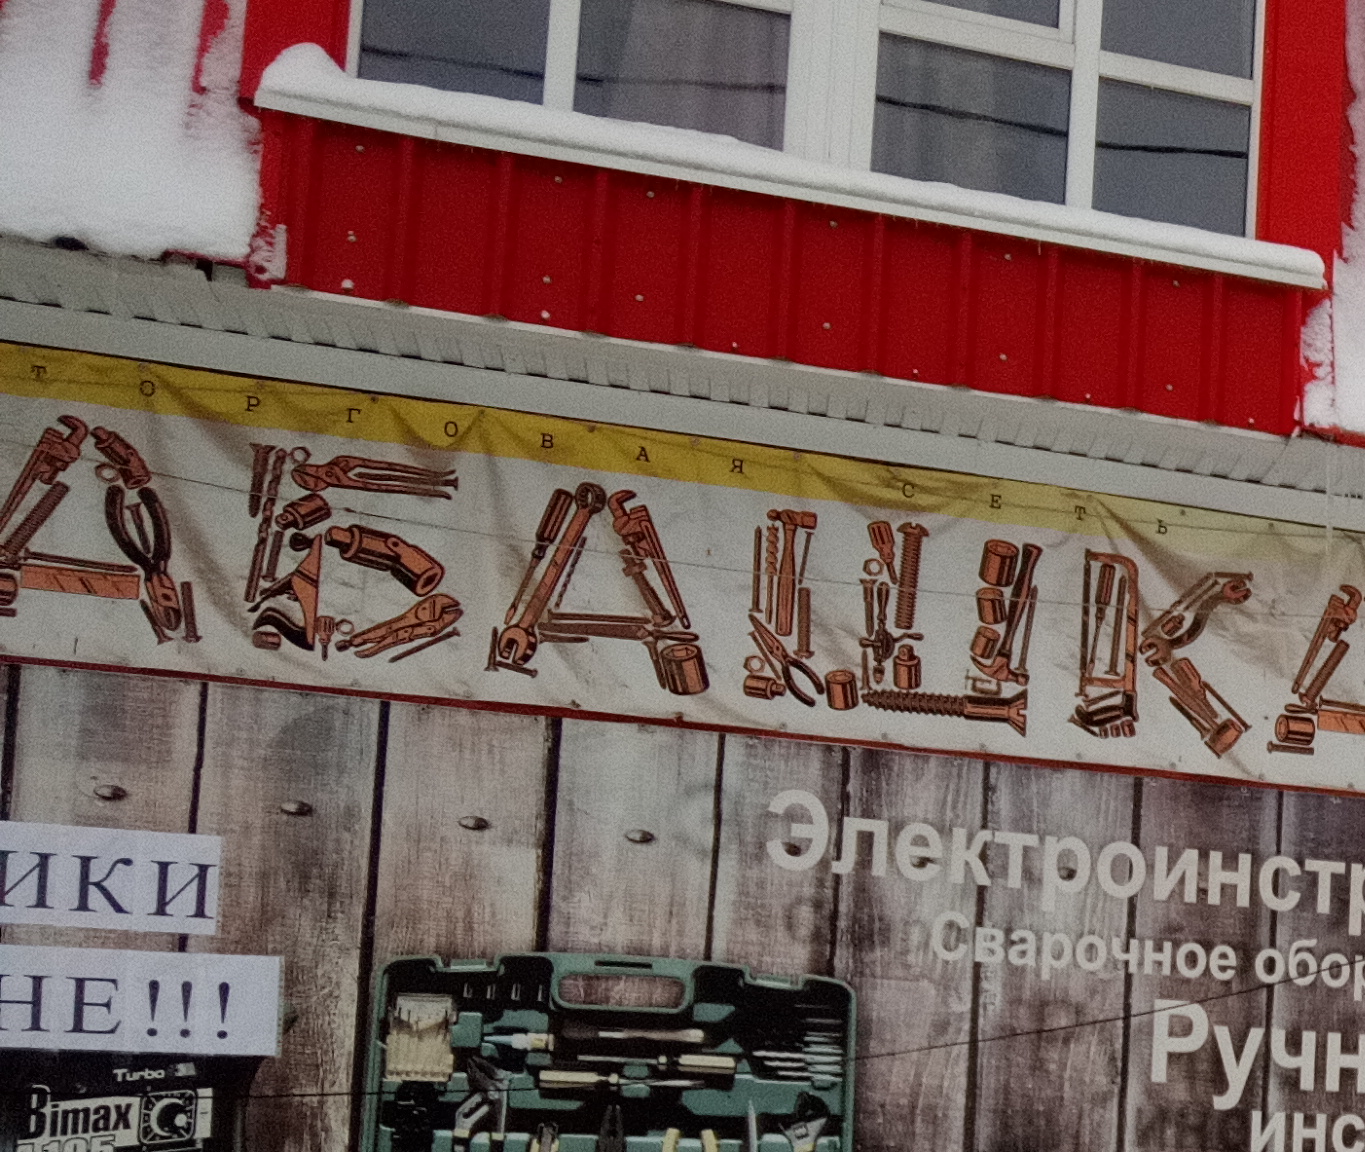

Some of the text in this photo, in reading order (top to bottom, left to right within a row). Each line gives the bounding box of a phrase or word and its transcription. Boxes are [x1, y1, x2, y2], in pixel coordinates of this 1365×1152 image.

[901, 481, 1168, 537] СЕТЬ
[0, 850, 217, 919] ИКИ
[933, 911, 1238, 982] Сварочное
[113, 1068, 166, 1082] Turbo
[29, 1085, 133, 1138] Bimax
